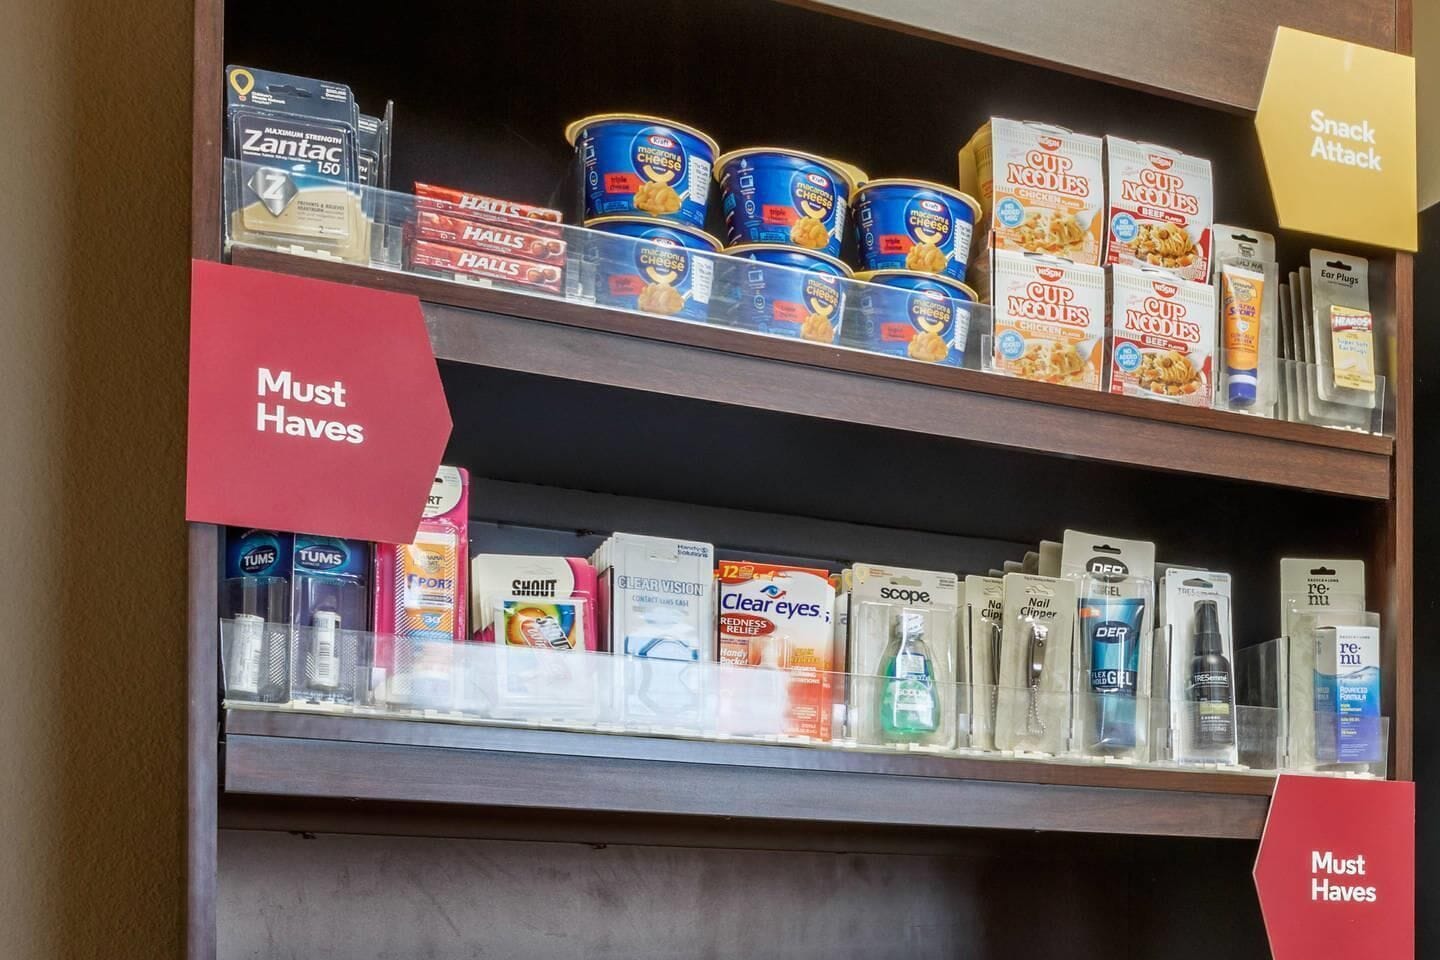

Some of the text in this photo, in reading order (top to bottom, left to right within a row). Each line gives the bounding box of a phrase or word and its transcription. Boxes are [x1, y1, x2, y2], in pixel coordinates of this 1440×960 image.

[264, 127, 342, 144] MAXIMUM STRENGTH
[1311, 109, 1376, 144] Snack
[242, 129, 342, 162] Zantac
[653, 136, 669, 146] Kraft
[638, 146, 676, 160] macaroni
[1026, 150, 1073, 174] CUP
[1310, 136, 1382, 171] Attack
[317, 161, 340, 175] 150
[263, 175, 286, 199] Z
[1007, 163, 1089, 197] NOODLES
[1140, 169, 1183, 193] CUP
[459, 195, 520, 217] HALLS
[1020, 190, 1060, 203] CHICKEN
[1122, 180, 1198, 215] NOODLES
[1143, 208, 1165, 219] BEEF
[463, 226, 525, 249] HALLS
[457, 250, 520, 276] HALLS
[1321, 270, 1359, 285] Ear Plugs
[1027, 282, 1074, 306] CUP
[1008, 296, 1090, 327] NOODLES
[1144, 297, 1186, 321] CUP
[1126, 309, 1200, 343] NOODLES
[1145, 336, 1168, 347] BEEF
[257, 367, 346, 408] Must
[256, 403, 364, 444] Haves
[243, 551, 275, 567] TUMS
[300, 549, 343, 565] TUMS
[722, 565, 739, 578] 12
[512, 579, 557, 597] SHOUT
[618, 575, 703, 596] CLEAR VISION
[881, 587, 930, 604] scope
[722, 593, 820, 619] Clear eyes
[1028, 598, 1050, 609] Nail
[1308, 594, 1330, 606] nu
[720, 617, 767, 628] REDNESS
[1020, 607, 1057, 618] Clipper
[726, 626, 760, 635] RELIEF
[1340, 653, 1362, 665] nu
[1311, 851, 1366, 875] Must
[1311, 878, 1377, 902] Haves
